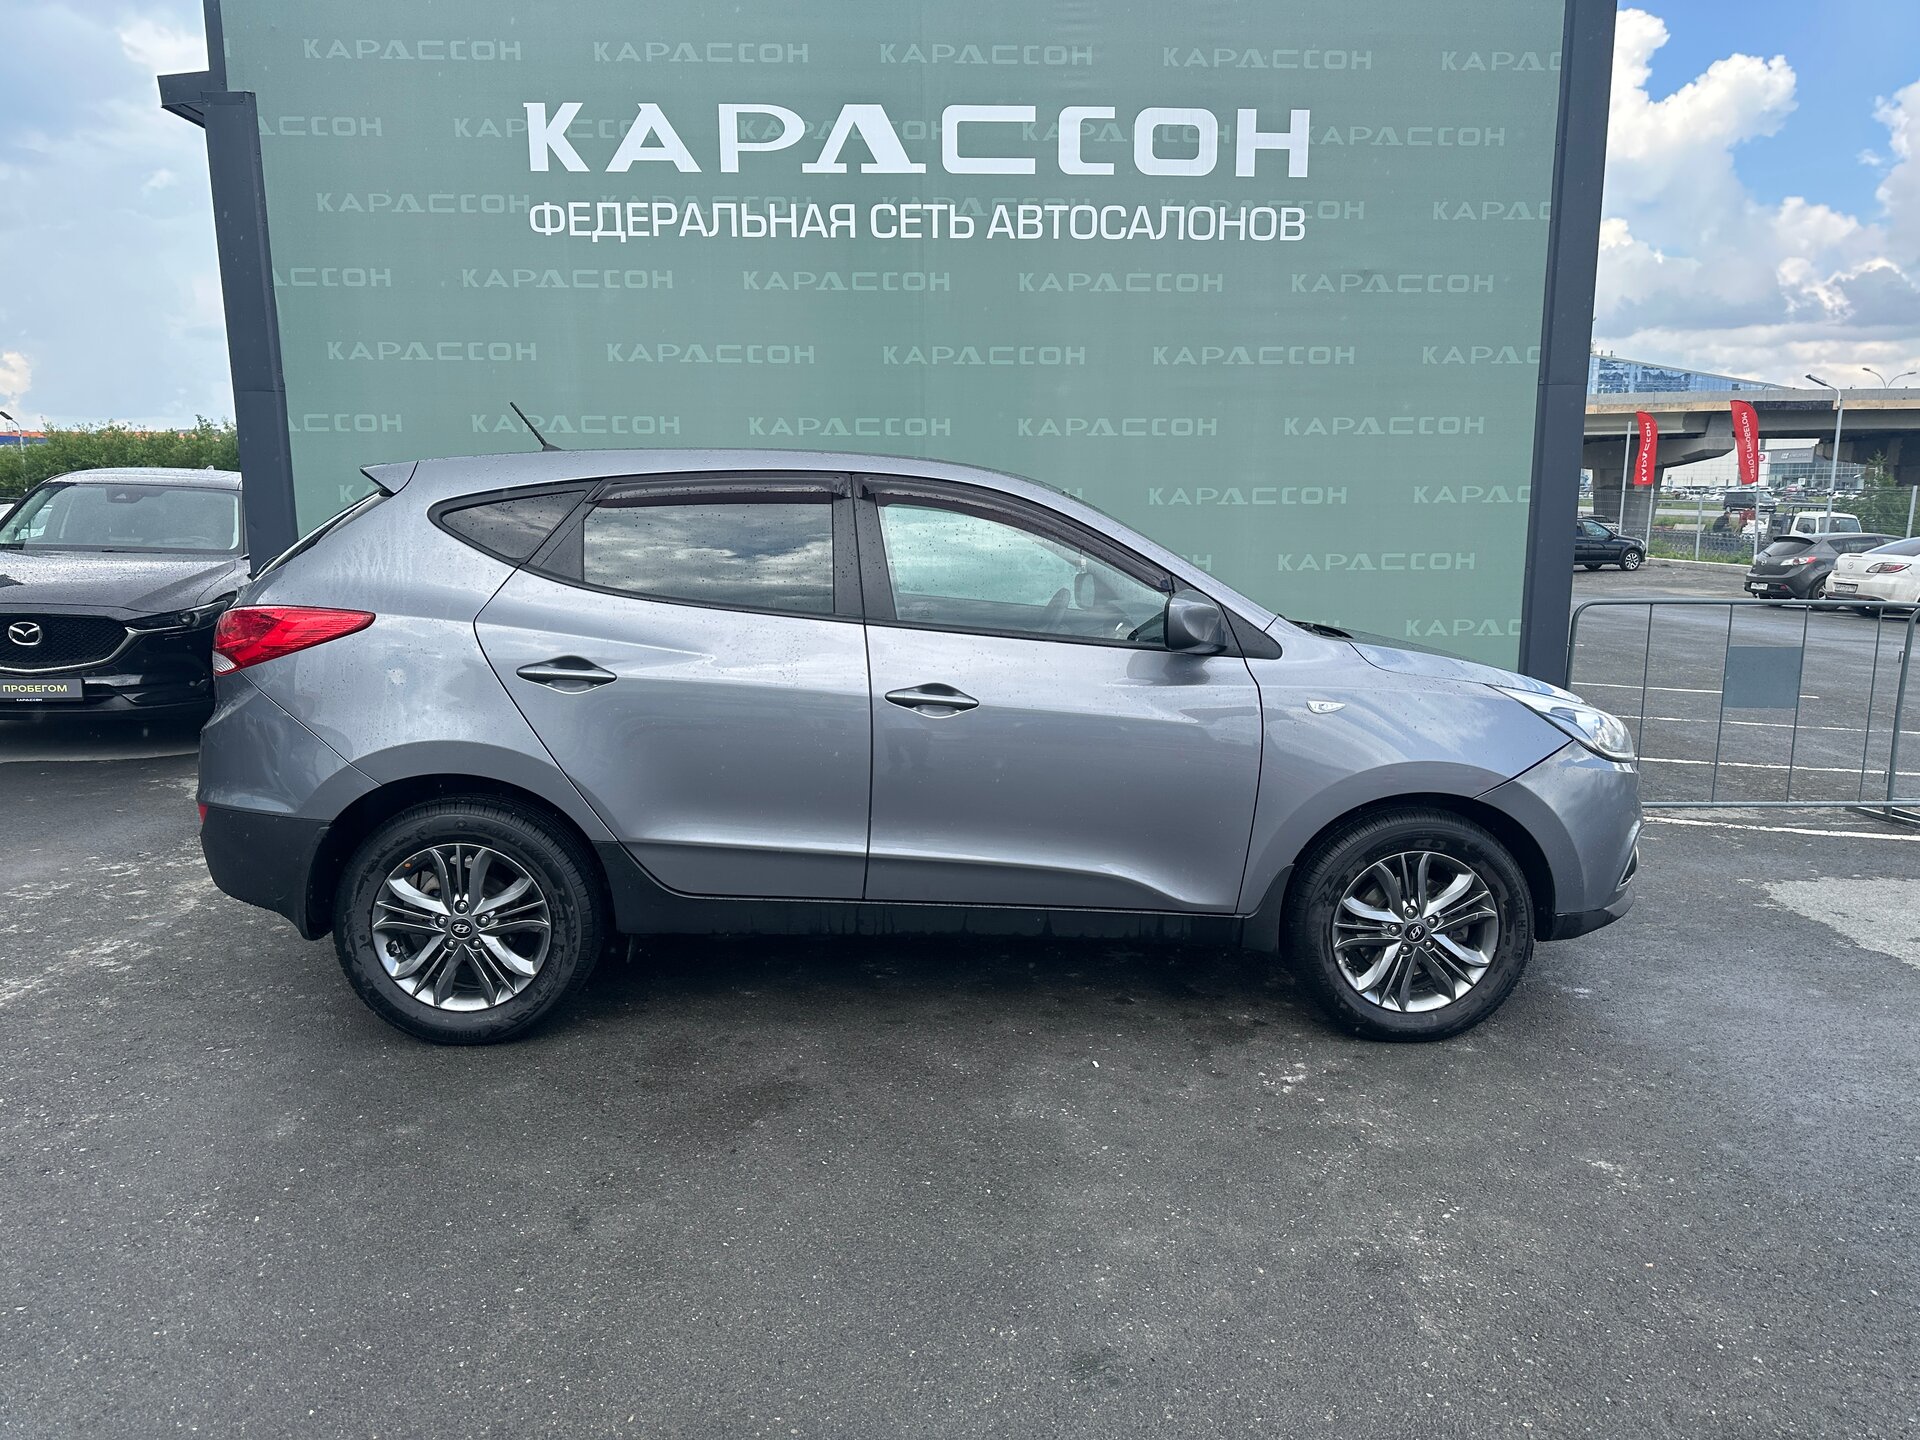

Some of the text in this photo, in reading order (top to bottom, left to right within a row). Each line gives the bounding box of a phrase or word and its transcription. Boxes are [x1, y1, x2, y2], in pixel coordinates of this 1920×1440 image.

[529, 202, 1307, 243] ФЕДЕРАЛЬНАЯ СЕТЬ АВТОСАЛОНОВ
[2, 684, 68, 693] ПРОБЕГОМ
